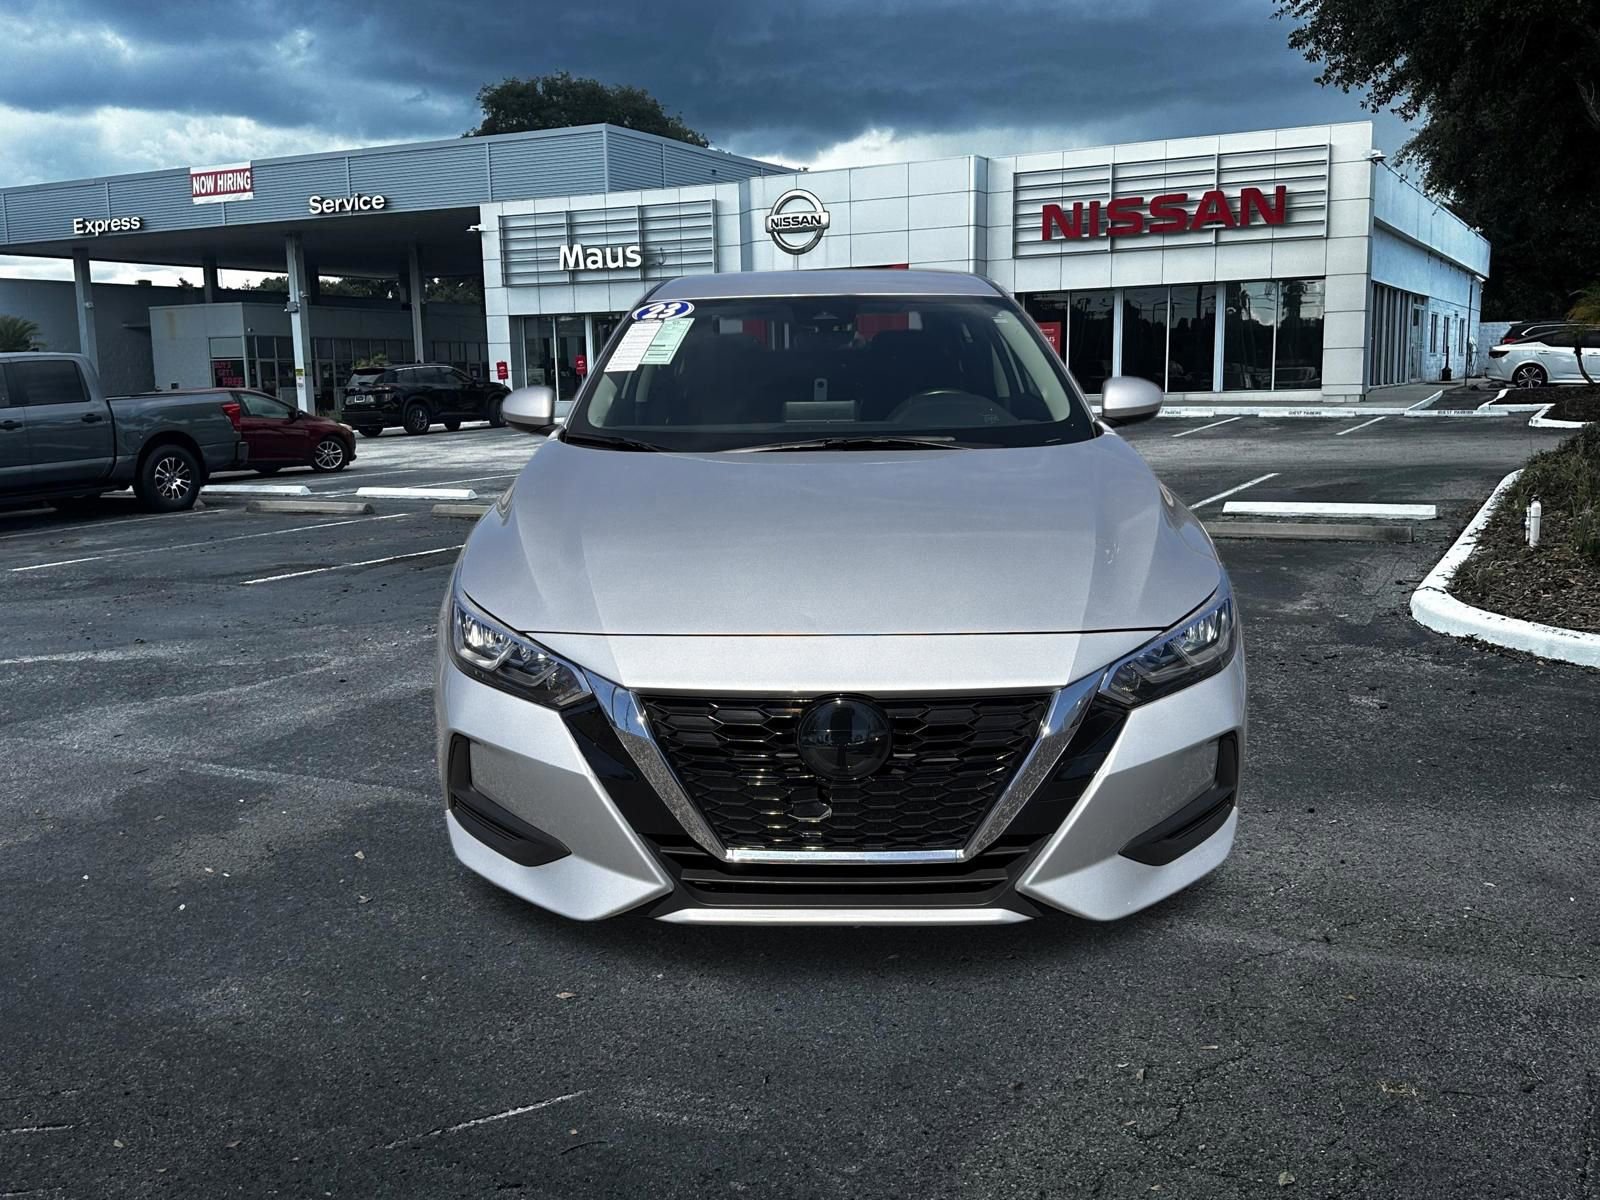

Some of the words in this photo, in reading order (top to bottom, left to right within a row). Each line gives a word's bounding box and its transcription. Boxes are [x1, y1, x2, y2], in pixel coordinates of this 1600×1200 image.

[192, 175, 215, 194] NOW
[217, 171, 251, 192] HIRING
[308, 193, 386, 215] Service
[1041, 185, 1287, 241] NISSAN
[73, 216, 141, 236] Express
[770, 215, 822, 228] NISSAN
[559, 244, 642, 271] Maus
[641, 301, 682, 319] 23
[223, 377, 244, 387] FREE
